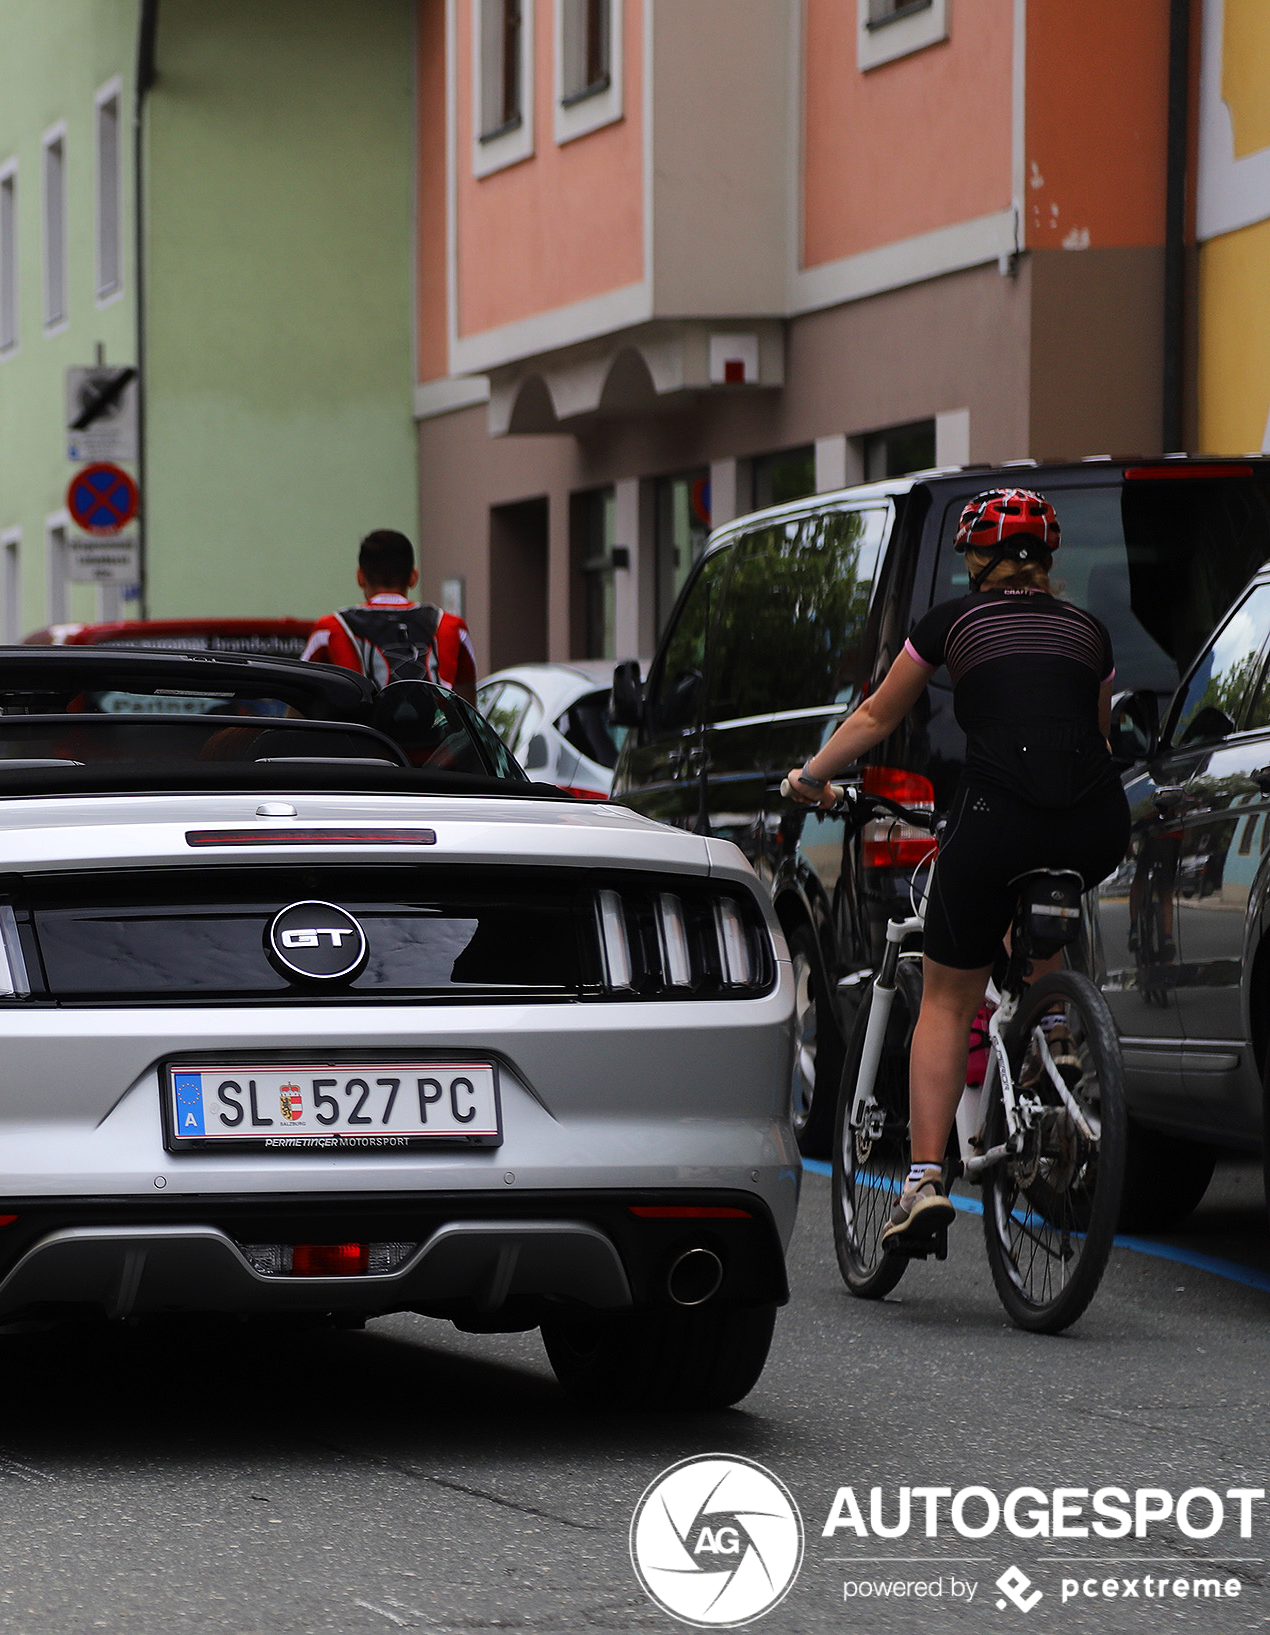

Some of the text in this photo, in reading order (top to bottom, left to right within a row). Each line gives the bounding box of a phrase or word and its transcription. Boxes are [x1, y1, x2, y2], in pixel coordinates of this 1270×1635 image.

[281, 928, 354, 948] GT
[217, 1077, 477, 1127] SL 527 PC
[184, 1112, 198, 1127] A
[339, 1137, 410, 1147] MOTORSPORT
